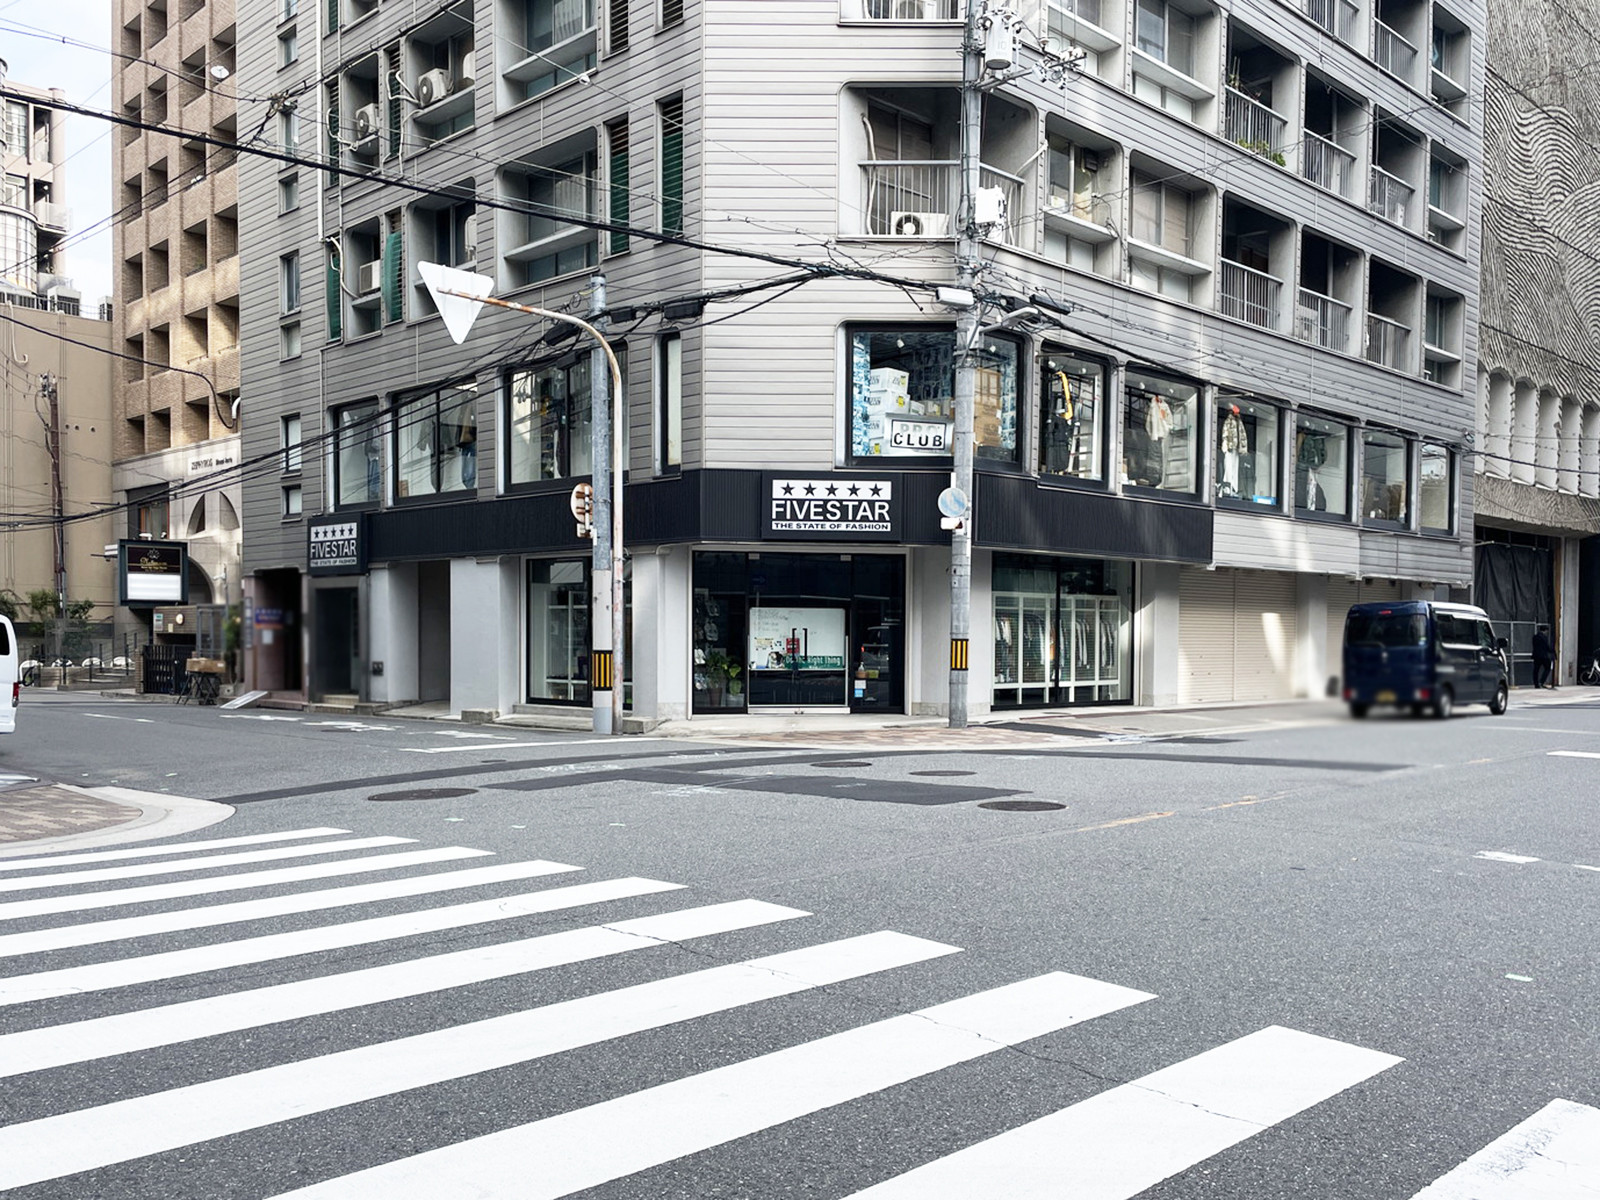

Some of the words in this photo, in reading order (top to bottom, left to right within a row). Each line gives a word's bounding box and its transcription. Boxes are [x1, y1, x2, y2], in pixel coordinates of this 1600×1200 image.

[893, 432, 943, 447] CLUB
[772, 501, 890, 521] FIVESTAR
[796, 522, 826, 530] STATE
[310, 540, 357, 558] FIVESTAR
